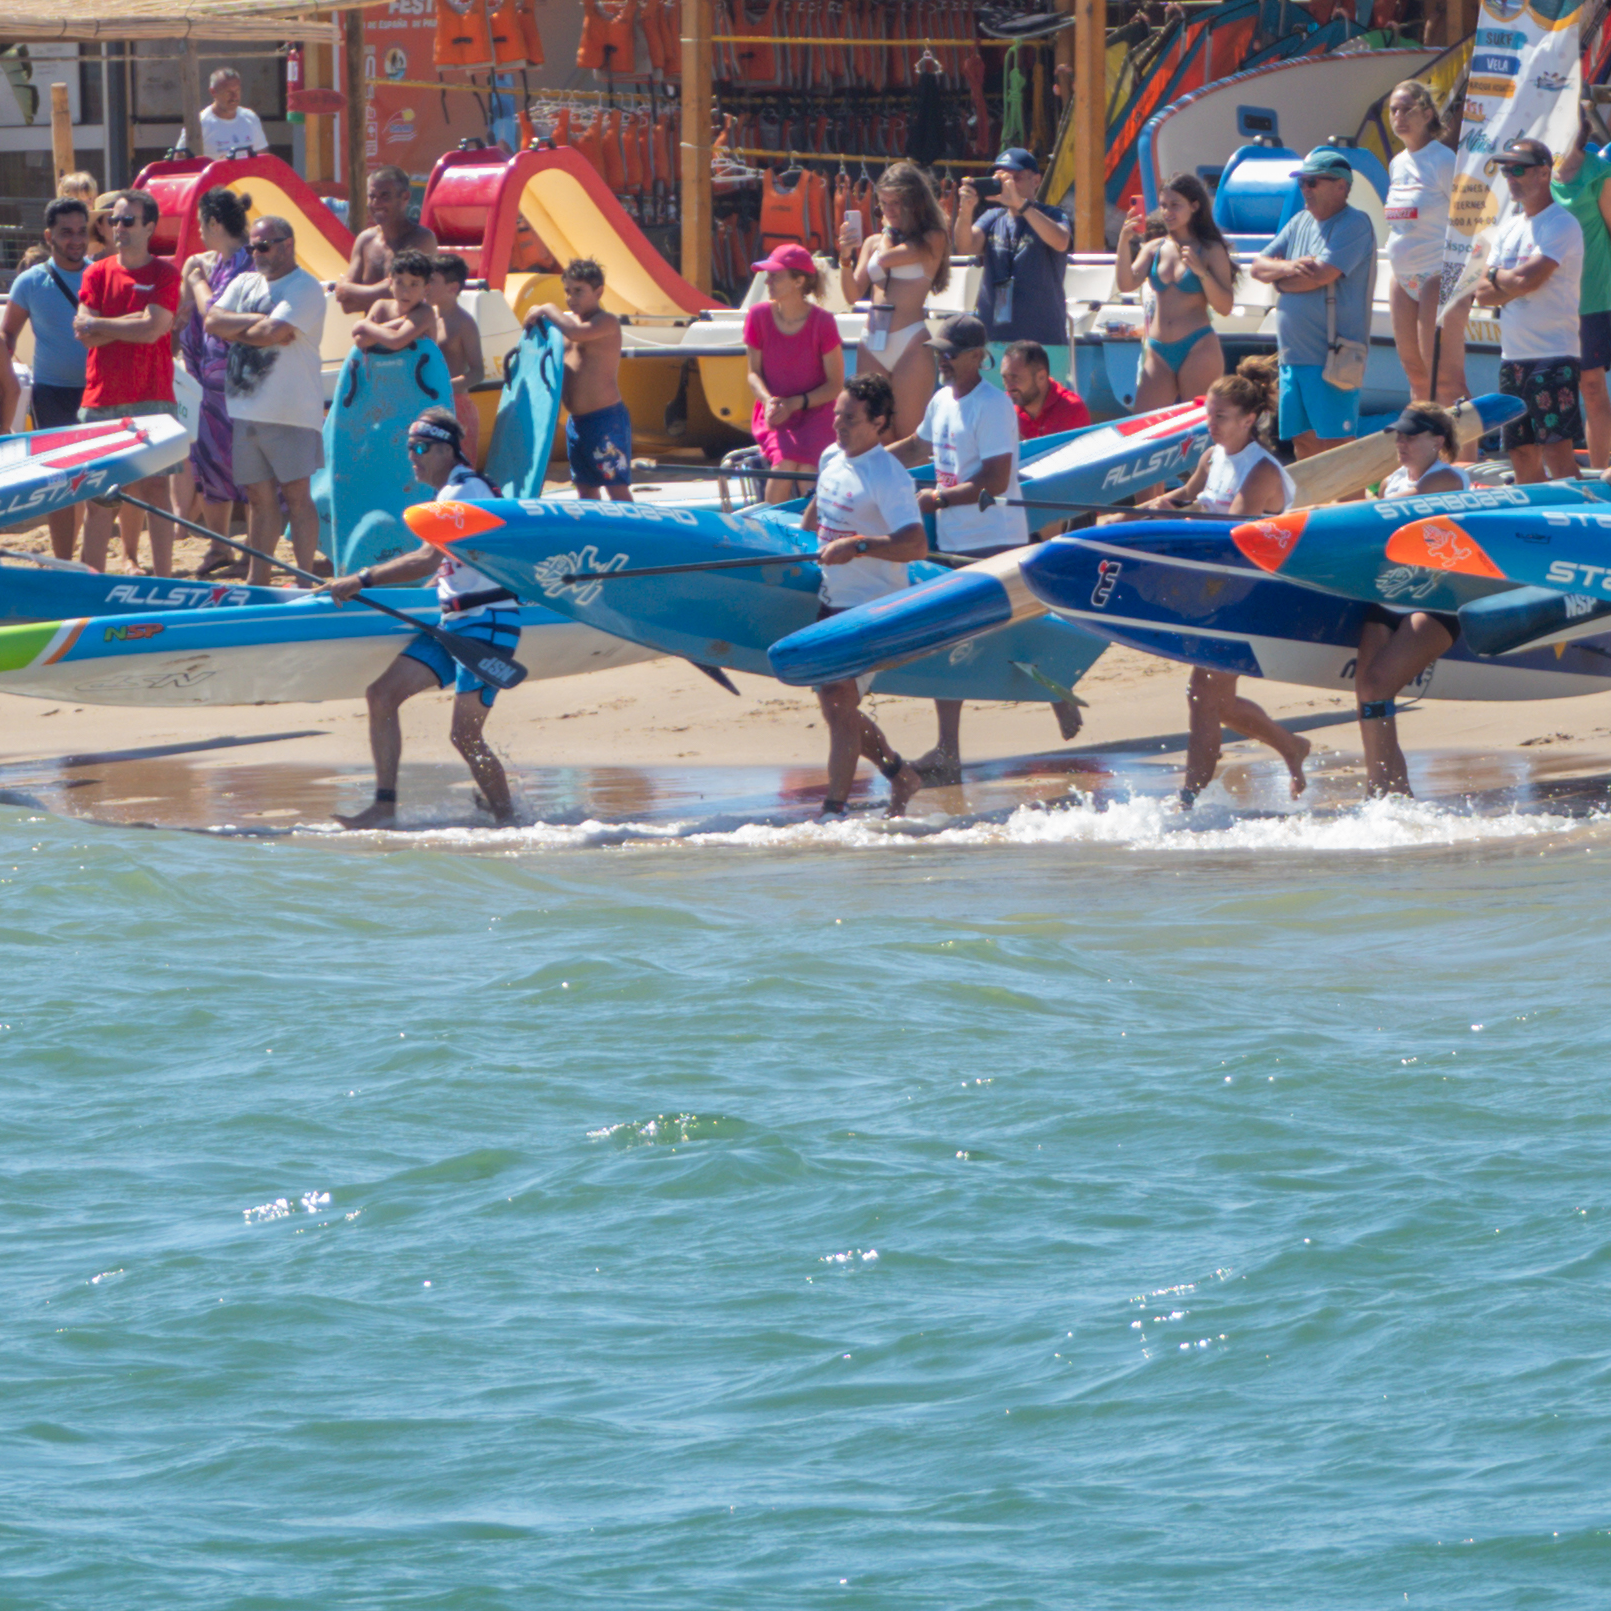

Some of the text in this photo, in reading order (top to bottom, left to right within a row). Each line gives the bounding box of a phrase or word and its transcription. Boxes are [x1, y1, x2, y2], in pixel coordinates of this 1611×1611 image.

[1486, 58, 1509, 72] VELA
[103, 623, 165, 642] NSP
[478, 656, 517, 683] NSP
